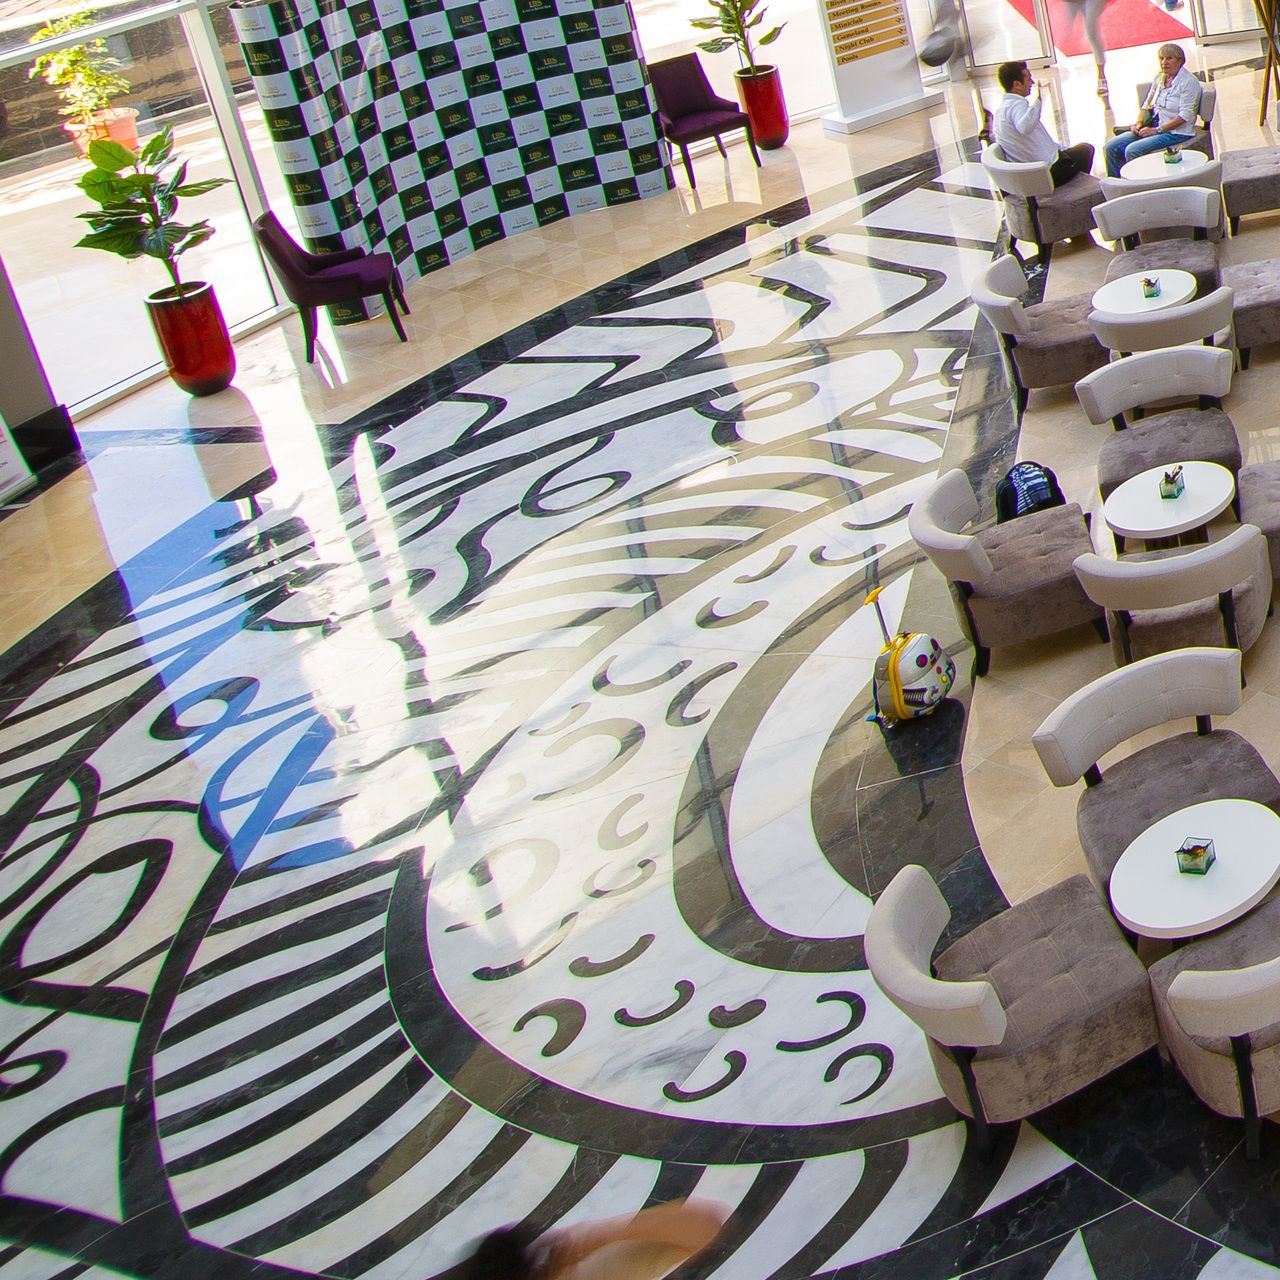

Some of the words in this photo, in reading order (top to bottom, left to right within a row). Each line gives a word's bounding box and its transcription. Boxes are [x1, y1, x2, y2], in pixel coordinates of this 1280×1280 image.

[830, 0, 847, 7] River
[832, 6, 858, 17] Meeting
[860, 1, 881, 10] Rooms
[834, 18, 863, 29] Miniclub
[837, 28, 869, 41] Gameland
[839, 42, 857, 52] Night
[859, 37, 874, 45] Club
[841, 54, 858, 63] Pools
